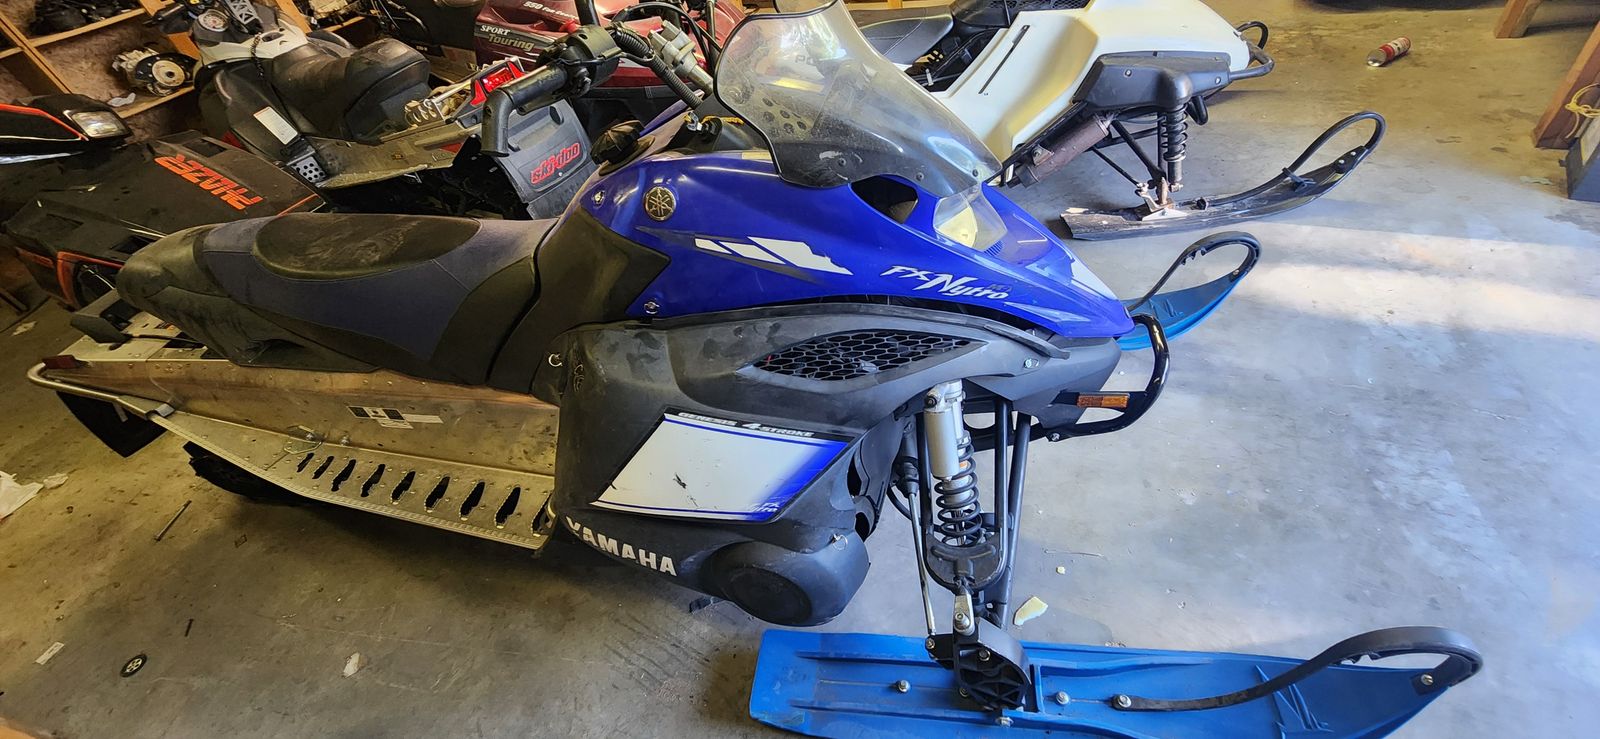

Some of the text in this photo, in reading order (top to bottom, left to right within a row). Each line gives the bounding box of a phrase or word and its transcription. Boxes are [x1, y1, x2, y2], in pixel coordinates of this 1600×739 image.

[523, 1, 544, 10] 550
[480, 24, 511, 36] SPORT
[488, 33, 534, 52] Touring
[154, 153, 263, 210] PHAZER
[678, 411, 738, 427] GENESIS
[565, 516, 678, 577] YAMAHA
